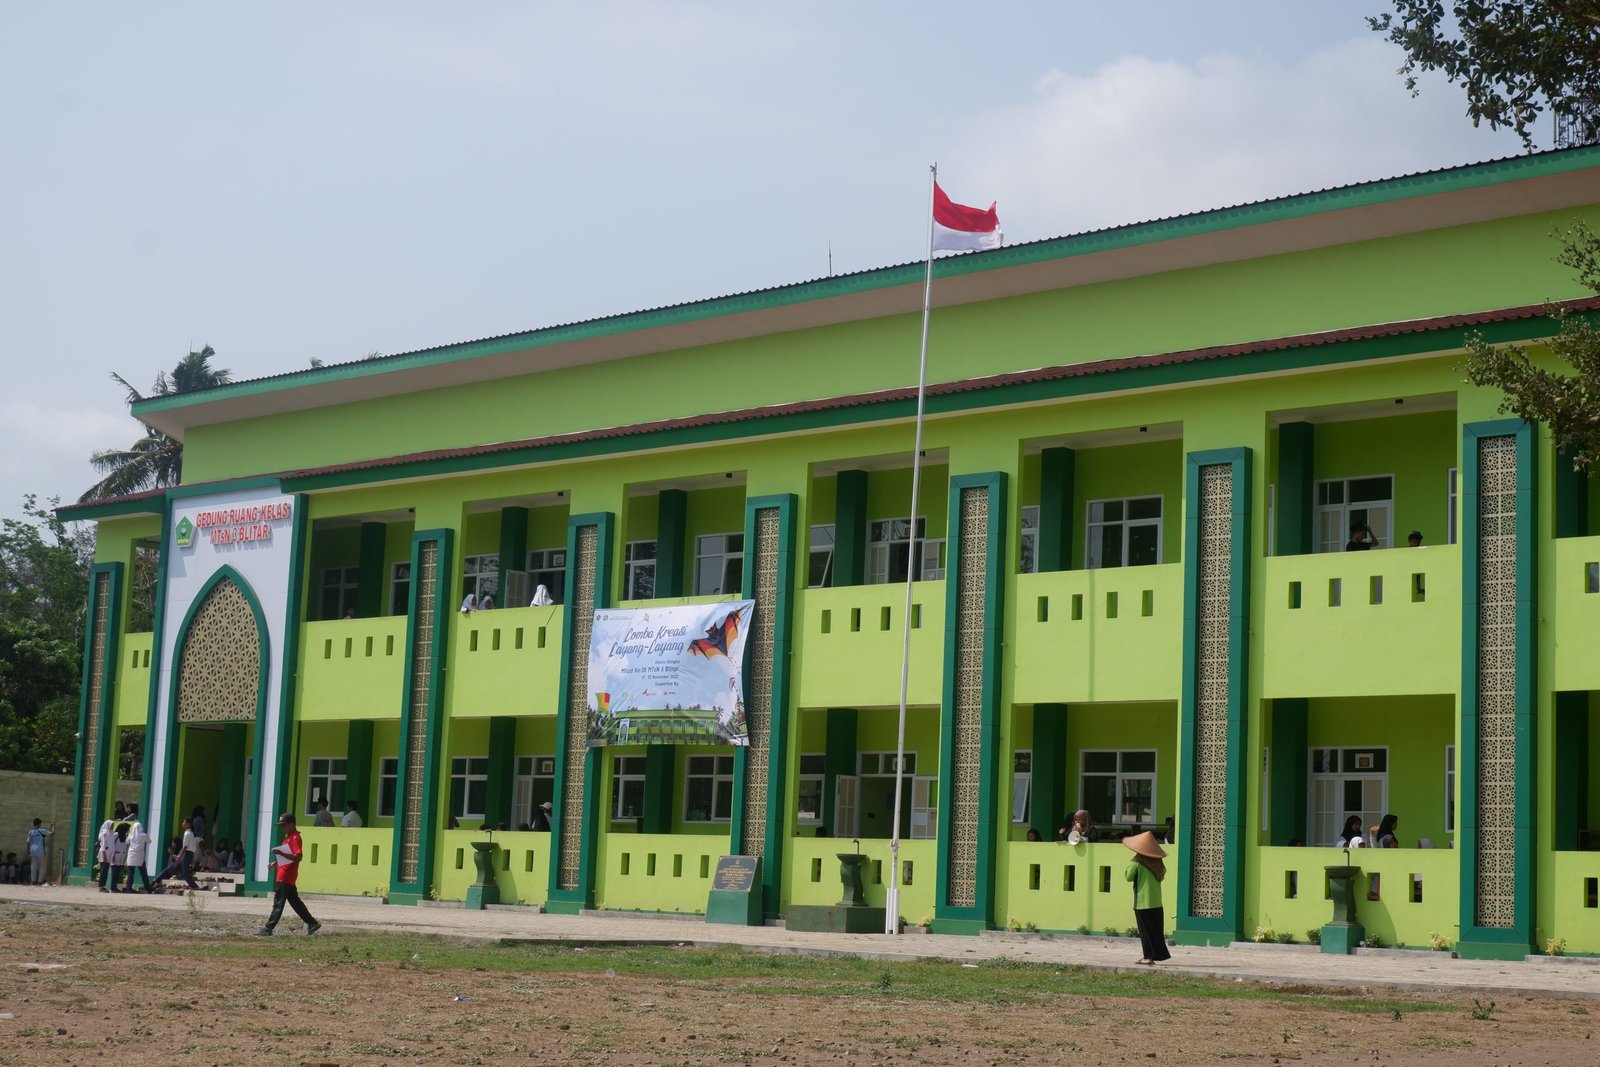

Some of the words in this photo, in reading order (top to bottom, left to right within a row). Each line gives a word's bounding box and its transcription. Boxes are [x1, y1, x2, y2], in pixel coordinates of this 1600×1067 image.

[196, 510, 229, 528] GEDUNG
[230, 506, 258, 523] RUANG
[261, 502, 288, 520] KELAS
[210, 528, 231, 545] MTsN
[233, 527, 238, 542] 3
[240, 524, 269, 541] BLITAR
[623, 626, 654, 643] Lomba
[655, 625, 689, 640] Kreasi
[608, 640, 684, 659] Layang-Layang
